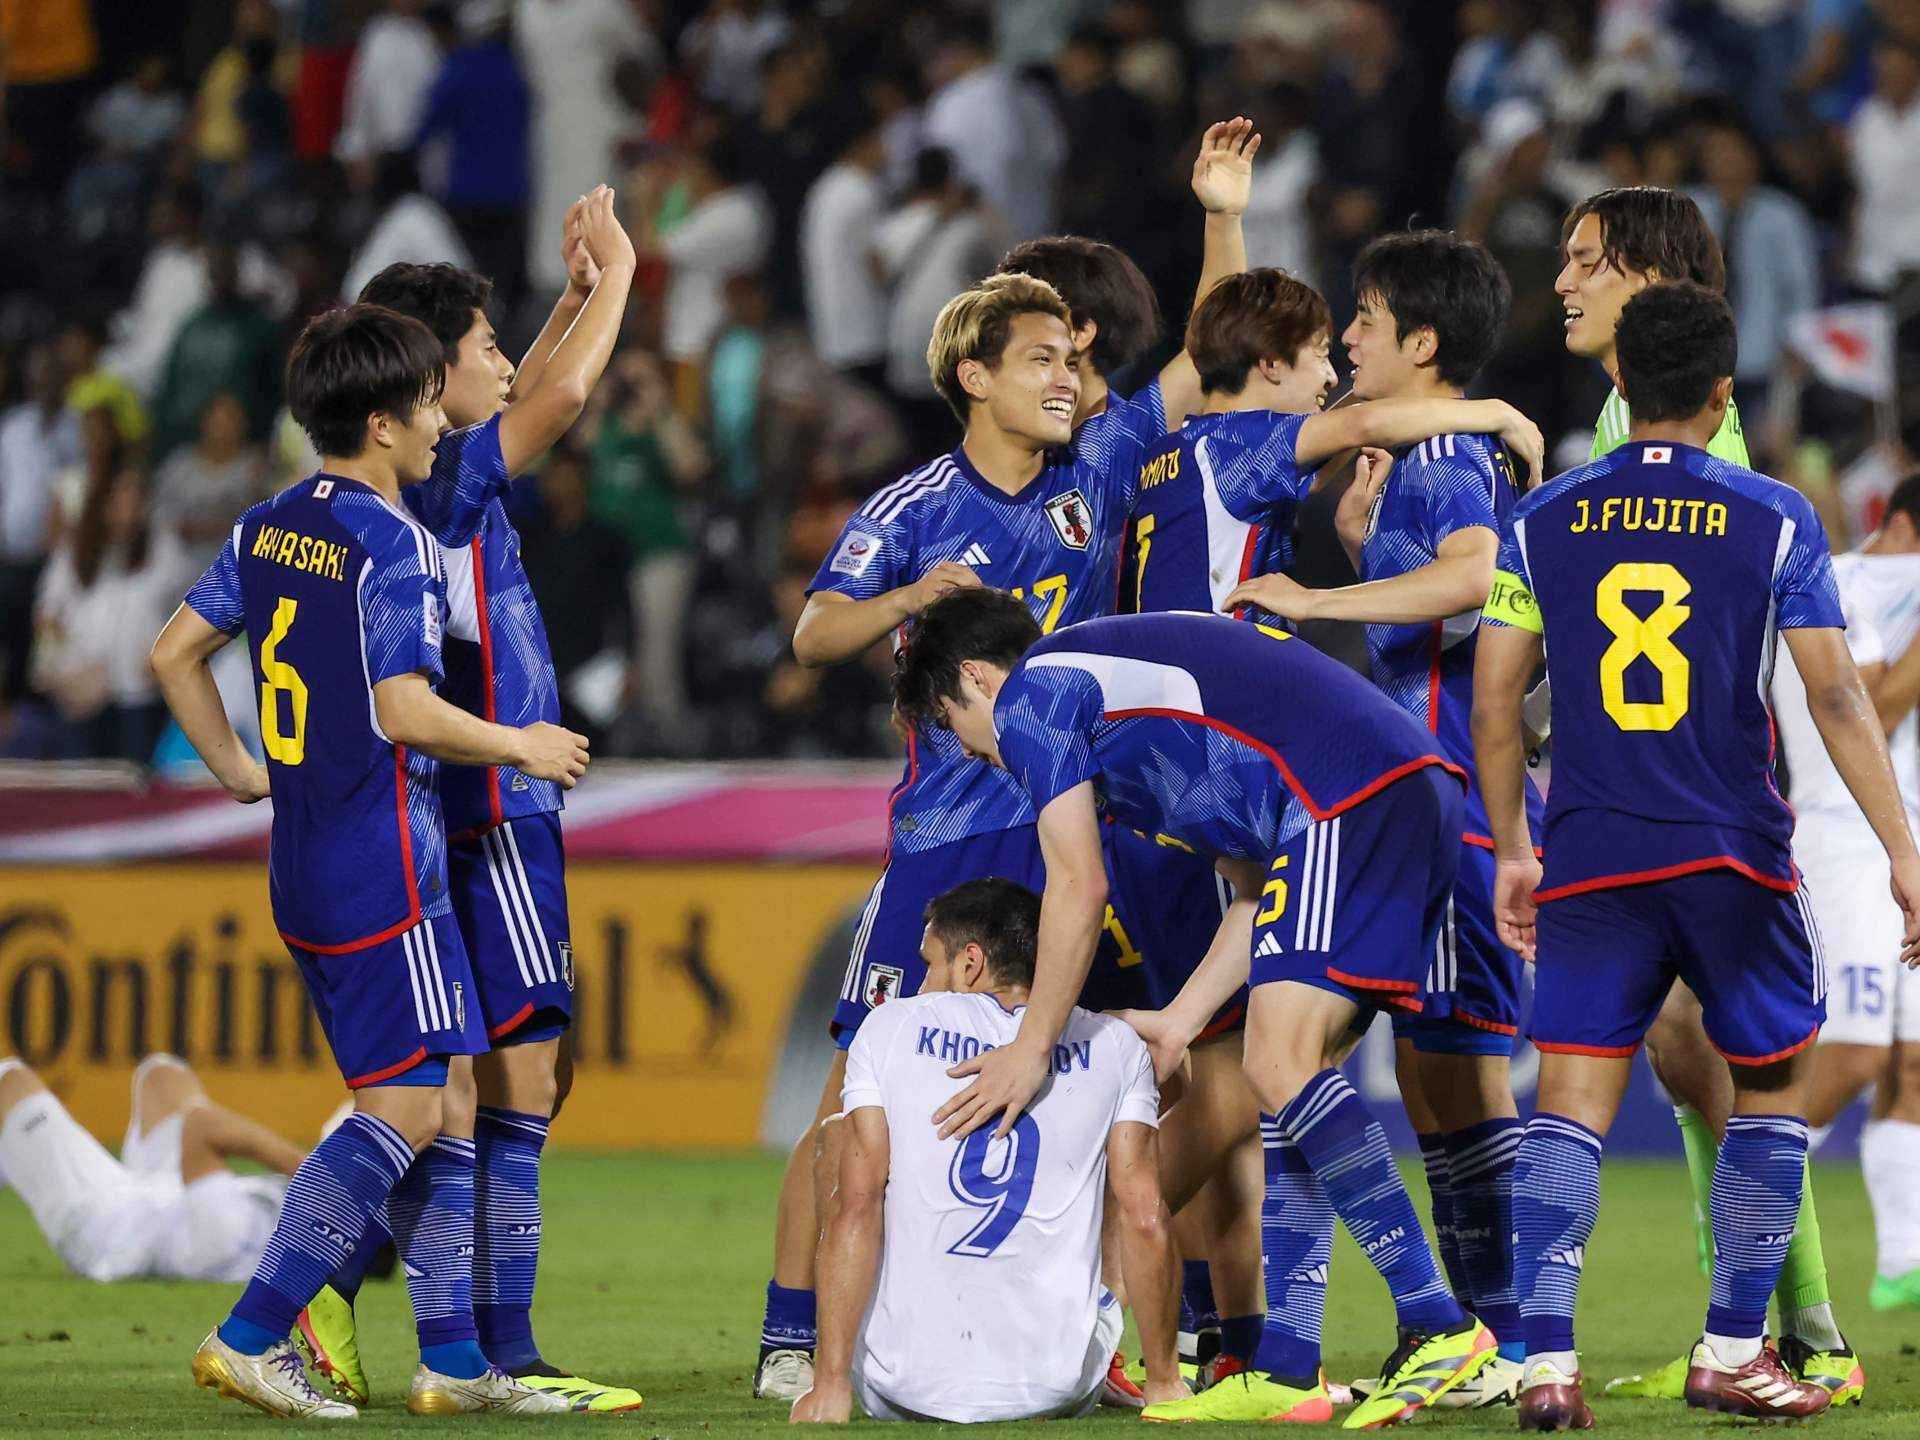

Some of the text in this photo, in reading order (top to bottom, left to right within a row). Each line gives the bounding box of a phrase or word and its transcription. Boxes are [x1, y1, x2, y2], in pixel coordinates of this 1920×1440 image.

[1569, 496, 1728, 537] J.FUJITA
[260, 595, 309, 766] 6
[1595, 561, 1693, 732] 8
[1839, 965, 1886, 1016] 15
[917, 1026, 1091, 1077] KHOOV
[946, 1110, 1041, 1259] 9
